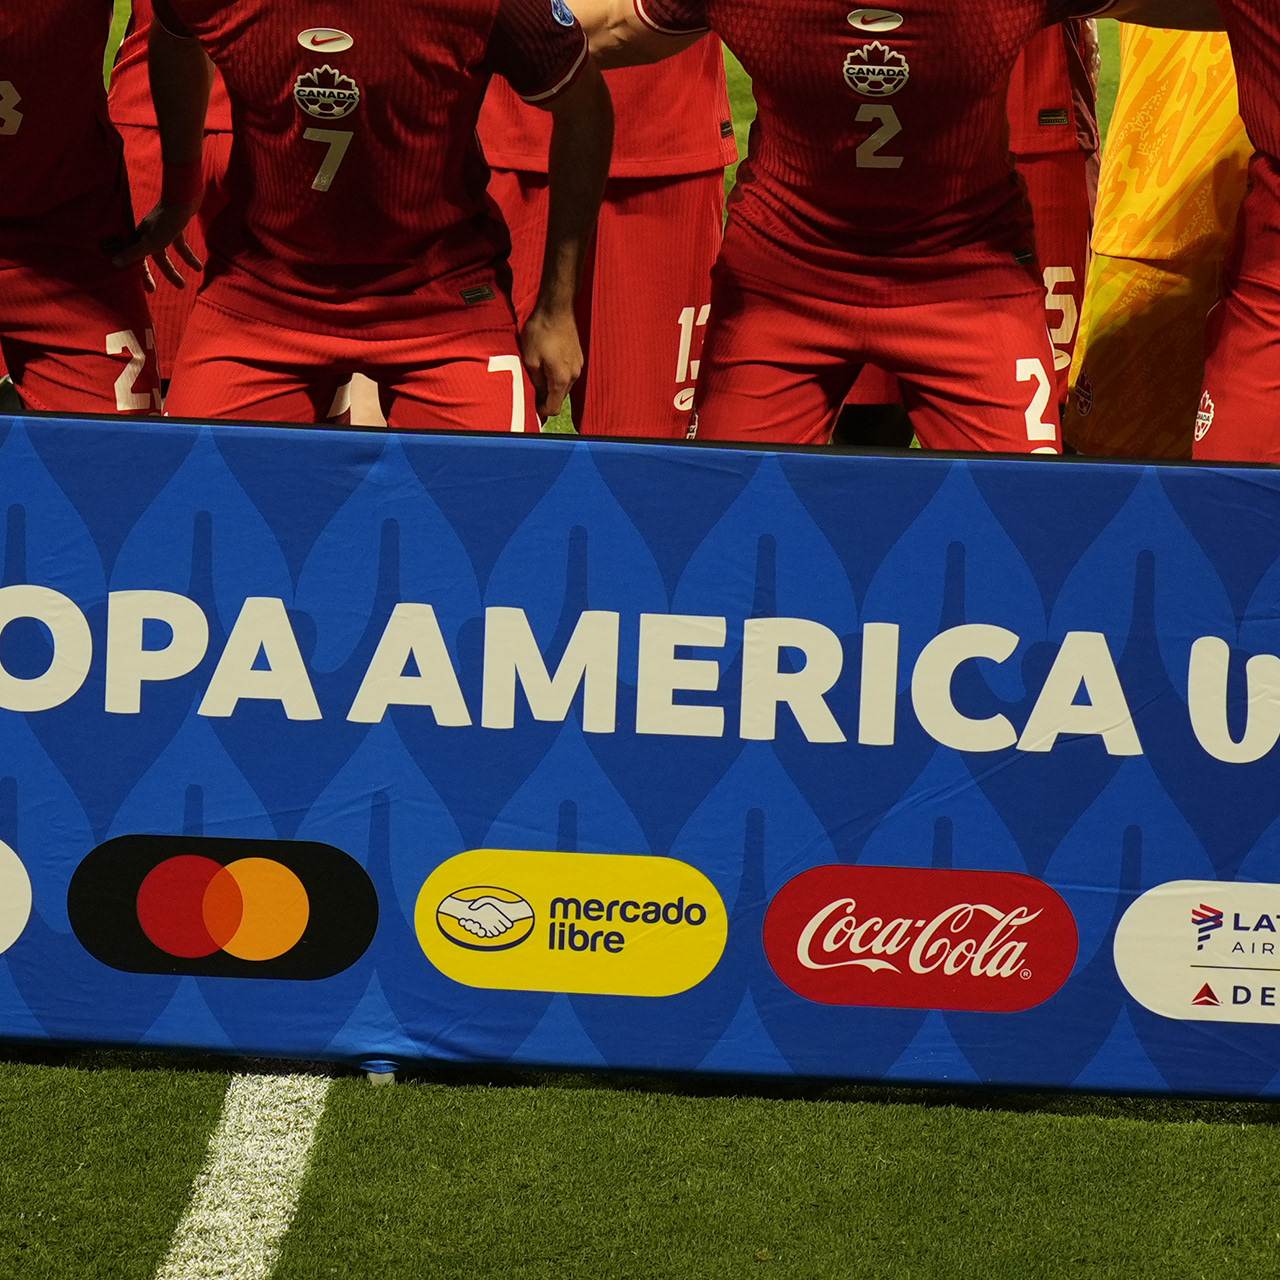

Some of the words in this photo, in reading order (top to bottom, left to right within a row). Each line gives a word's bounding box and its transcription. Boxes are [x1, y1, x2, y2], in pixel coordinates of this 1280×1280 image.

[296, 88, 357, 101] CANADA
[845, 66, 906, 78] CANADA
[302, 127, 354, 193] 7
[854, 103, 904, 169] 2
[105, 329, 161, 411] 2
[487, 354, 526, 433] 7
[1016, 358, 1056, 441] 2
[347, 603, 1144, 756] AMERICA
[548, 922, 625, 954] libre
[549, 896, 707, 927] mercado
[797, 898, 1044, 980] Coca-Cola
